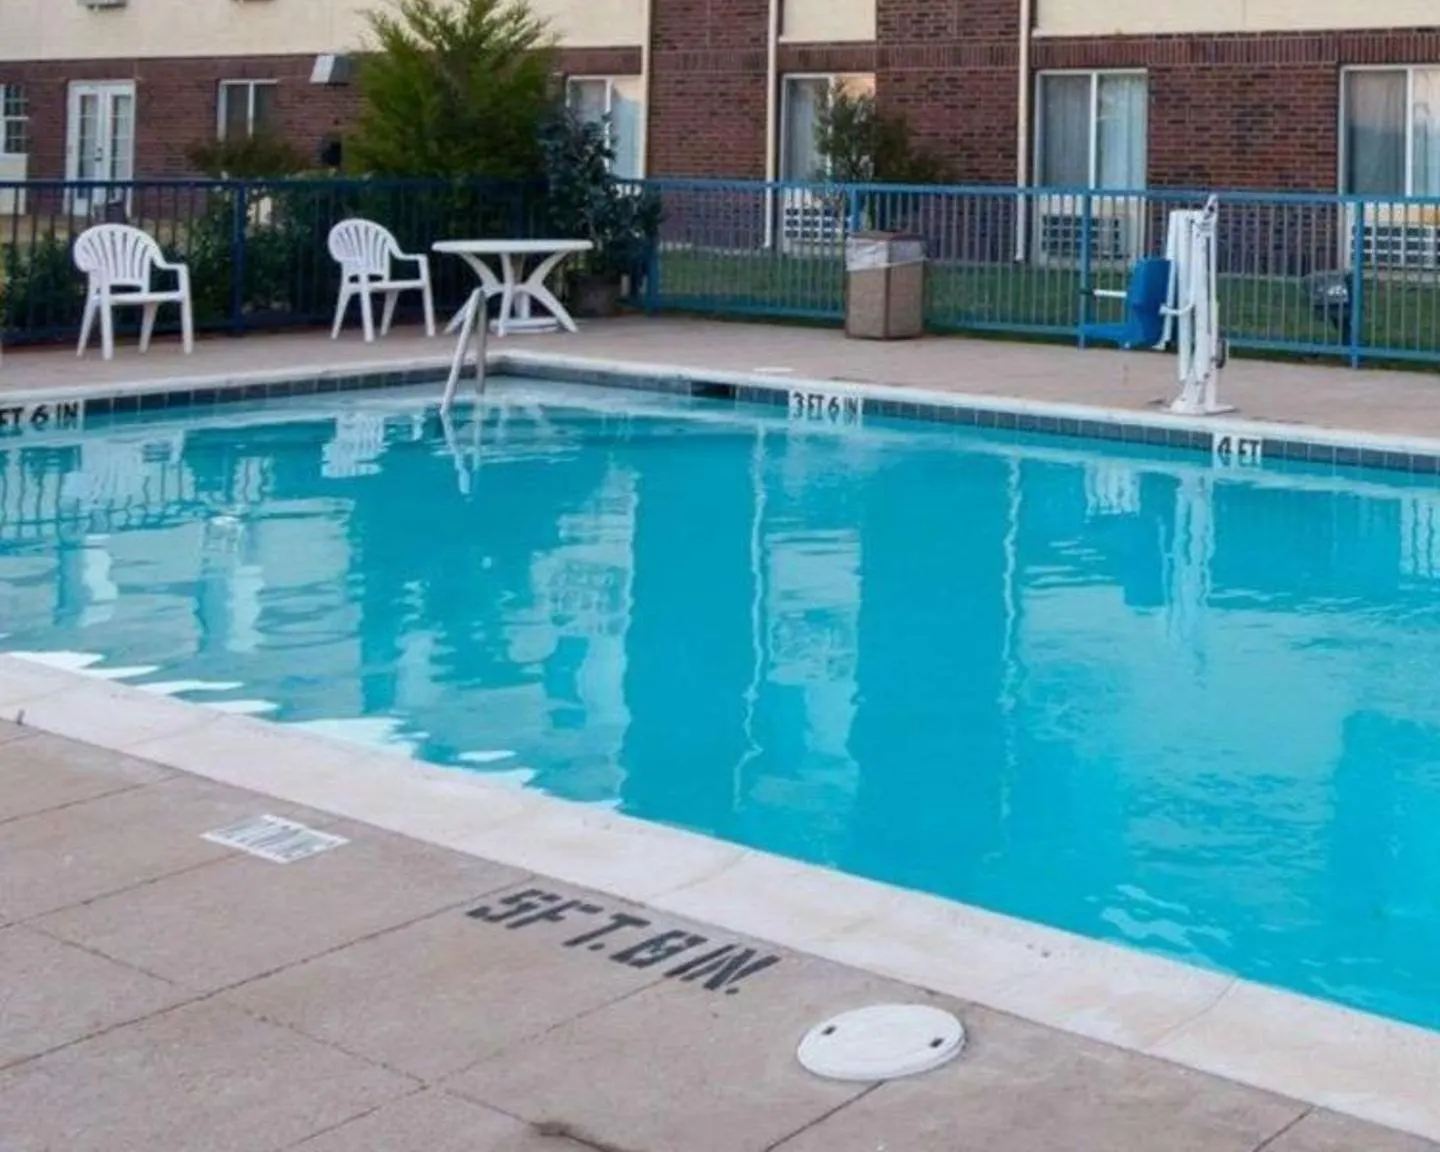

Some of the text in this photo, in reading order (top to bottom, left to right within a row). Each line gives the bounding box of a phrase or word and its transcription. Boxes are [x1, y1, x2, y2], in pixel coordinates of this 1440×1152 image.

[30, 404, 49, 424] 6
[56, 401, 78, 420] IN
[1217, 436, 1260, 456] 4 FT
